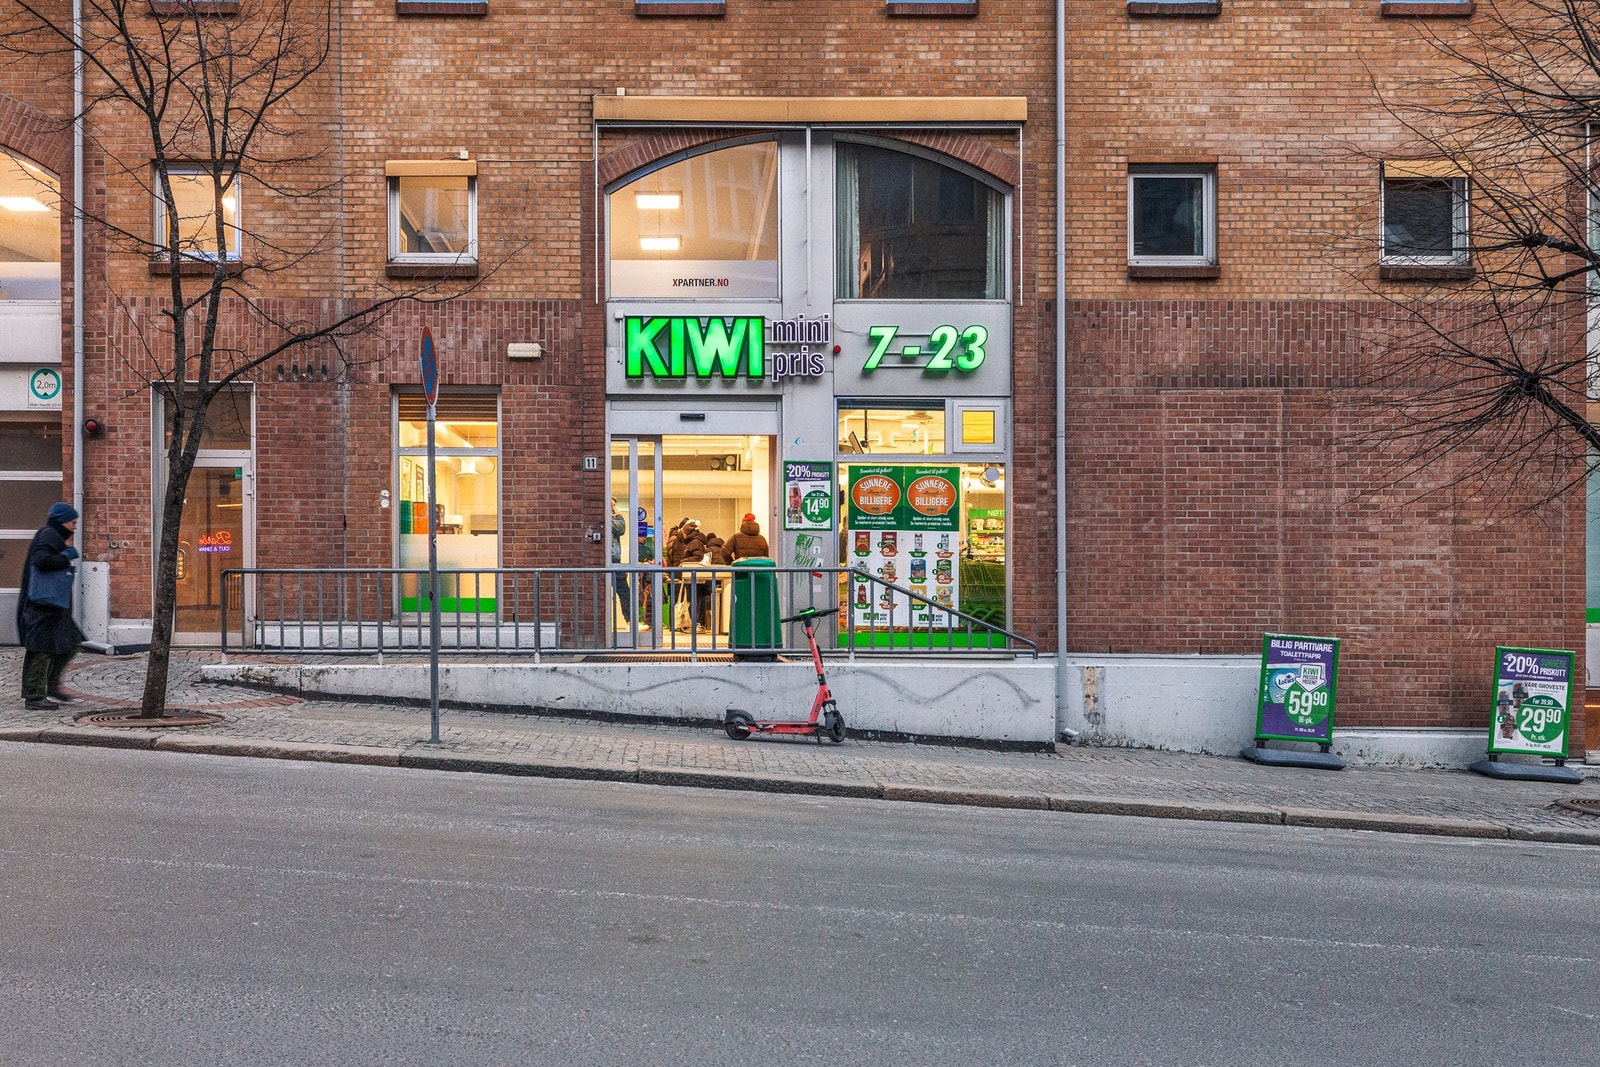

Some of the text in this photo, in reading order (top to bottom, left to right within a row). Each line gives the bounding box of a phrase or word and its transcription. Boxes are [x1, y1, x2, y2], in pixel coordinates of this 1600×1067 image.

[672, 278, 729, 287] XPARTNER.NO
[624, 313, 830, 379] KIWI mini
[771, 345, 826, 382] pris
[586, 458, 595, 468] 11
[786, 465, 811, 478] -20%
[860, 478, 893, 492] SUNNERE
[915, 479, 949, 493] SUNNERE
[860, 496, 893, 505] BILLIGERE
[915, 497, 949, 506] BILLIGERE
[1271, 640, 1333, 653] BILLIG PARTIVARE
[1281, 651, 1321, 660] TOALETTPAPIR
[1503, 655, 1539, 674] -20%
[1303, 667, 1319, 675] KIWI
[1540, 667, 1566, 677] PRISKUTT
[1278, 677, 1294, 686] Lotus
[1538, 683, 1566, 691] GROVESTE
